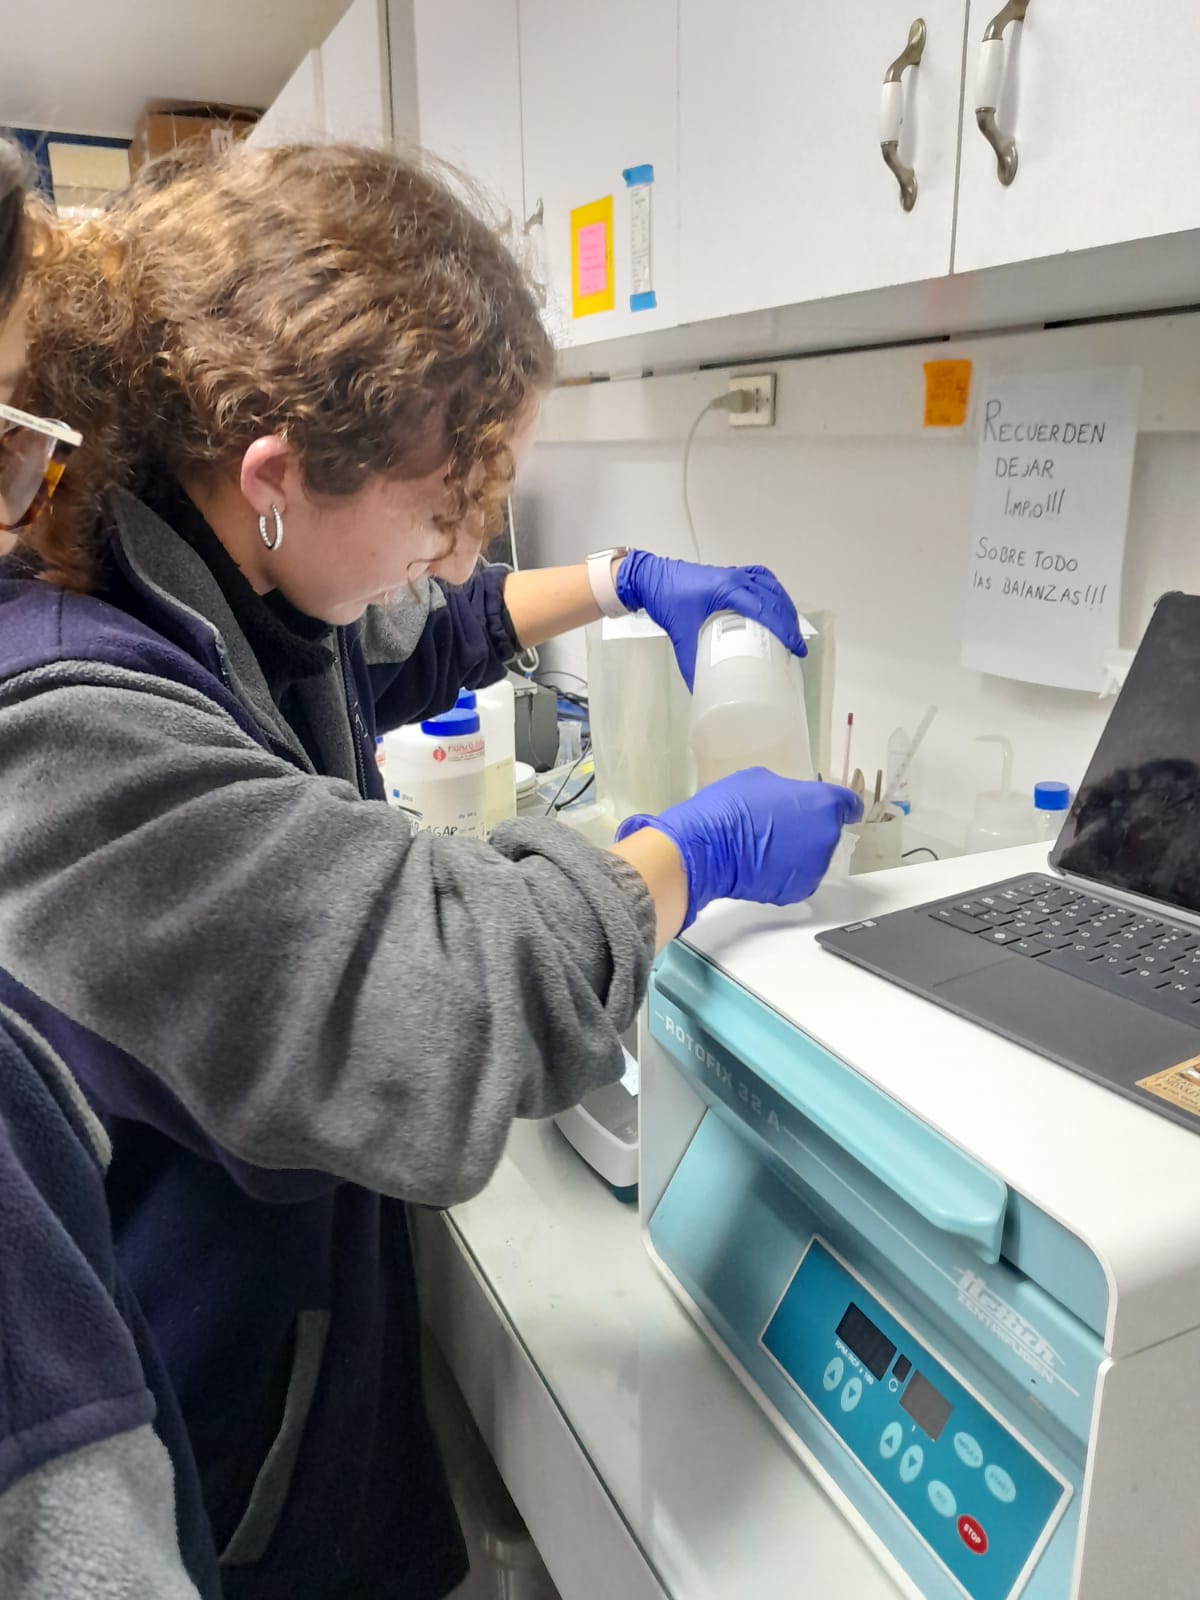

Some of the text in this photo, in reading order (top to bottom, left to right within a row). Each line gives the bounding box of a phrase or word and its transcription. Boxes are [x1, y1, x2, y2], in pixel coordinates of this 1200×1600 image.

[984, 400, 1105, 443] RECUERDEN
[995, 456, 1055, 479] DEJAR
[976, 536, 1079, 572] SOBRE TODO
[665, 1015, 733, 1089] ROTOFIX
[767, 1109, 780, 1133] A
[963, 1523, 982, 1544] STOP
